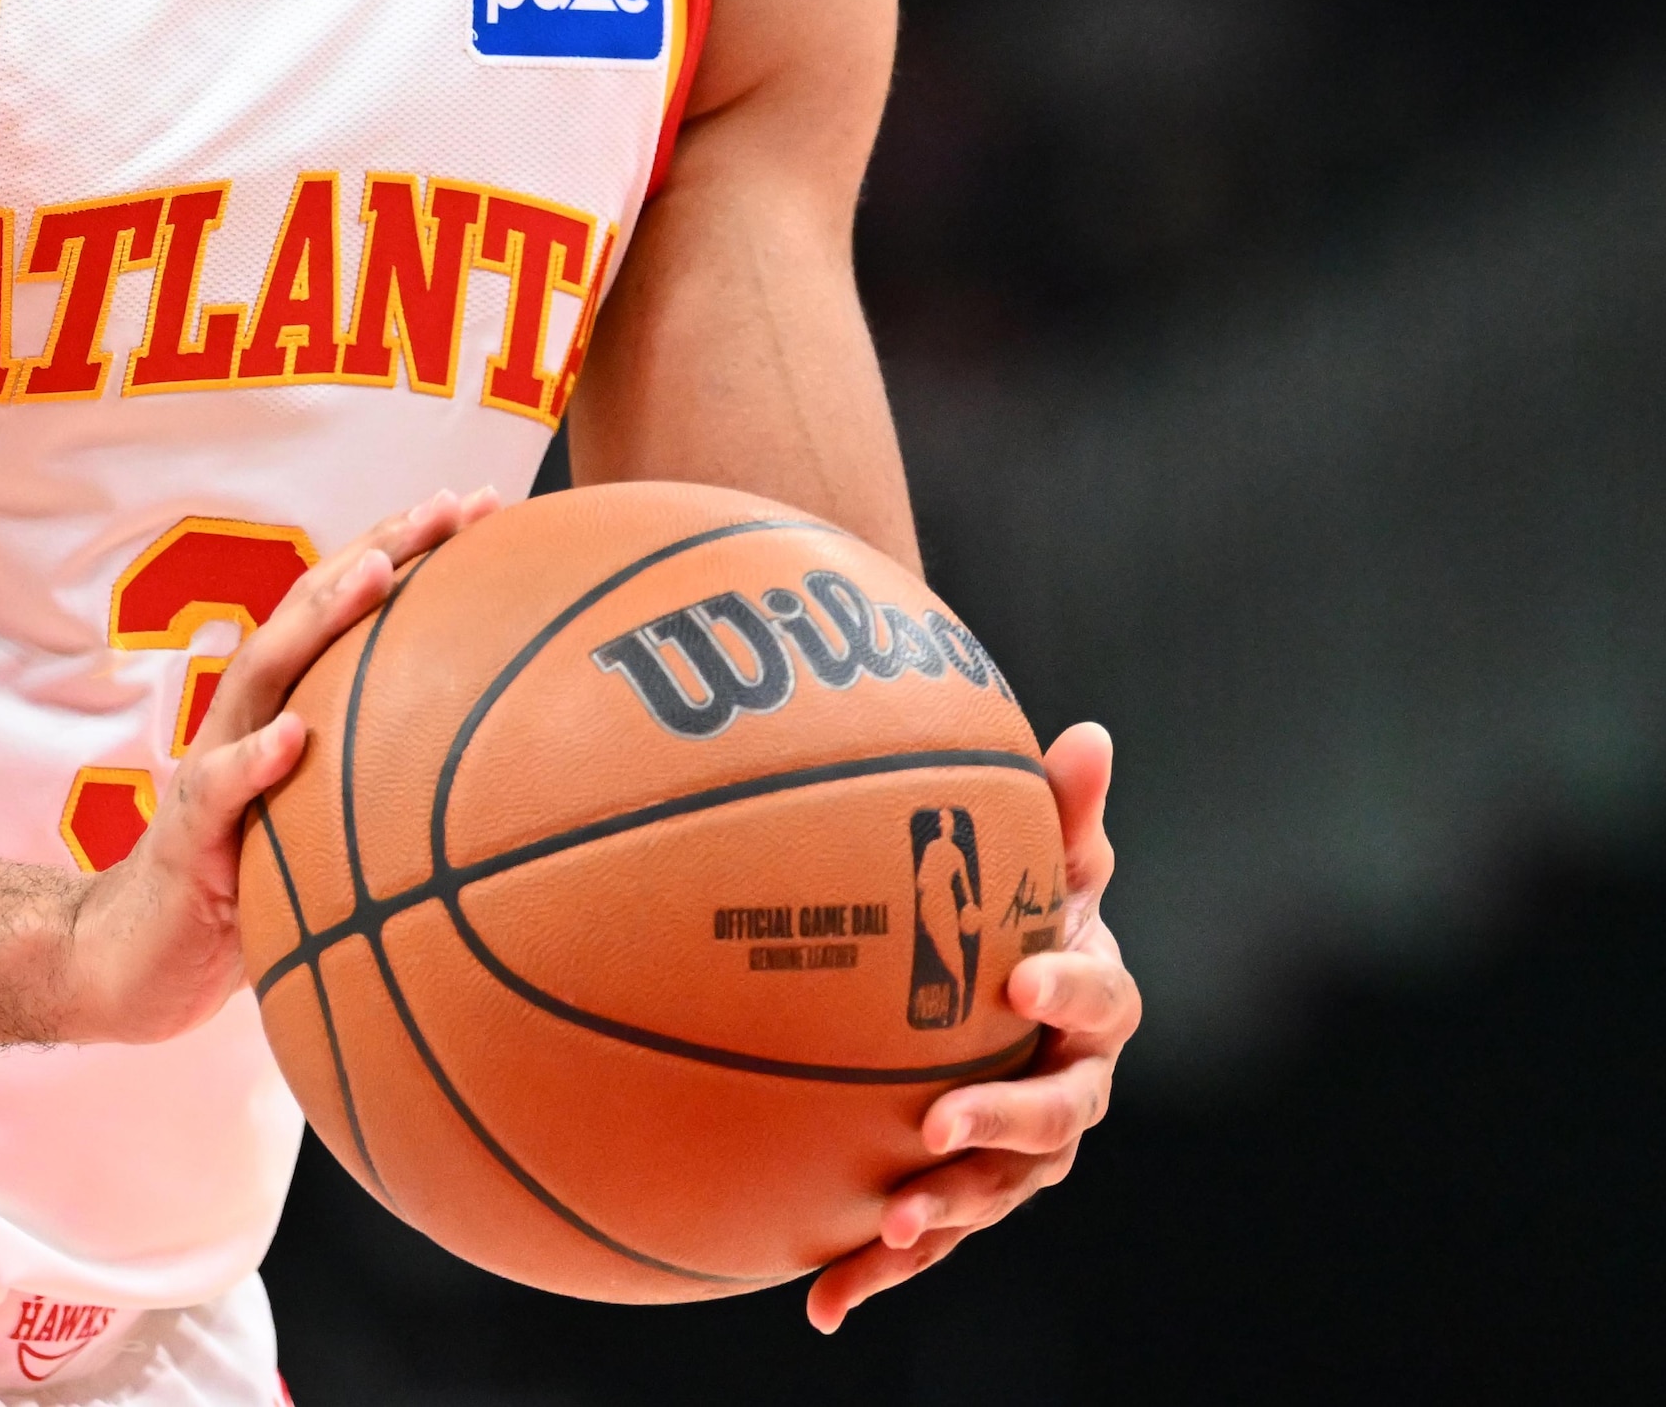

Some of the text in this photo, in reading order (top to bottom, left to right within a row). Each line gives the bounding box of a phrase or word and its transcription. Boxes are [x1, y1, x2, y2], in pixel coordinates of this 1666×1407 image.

[590, 570, 1016, 740] Wilso
[715, 903, 889, 940] OFFICIAL GAME BALL
